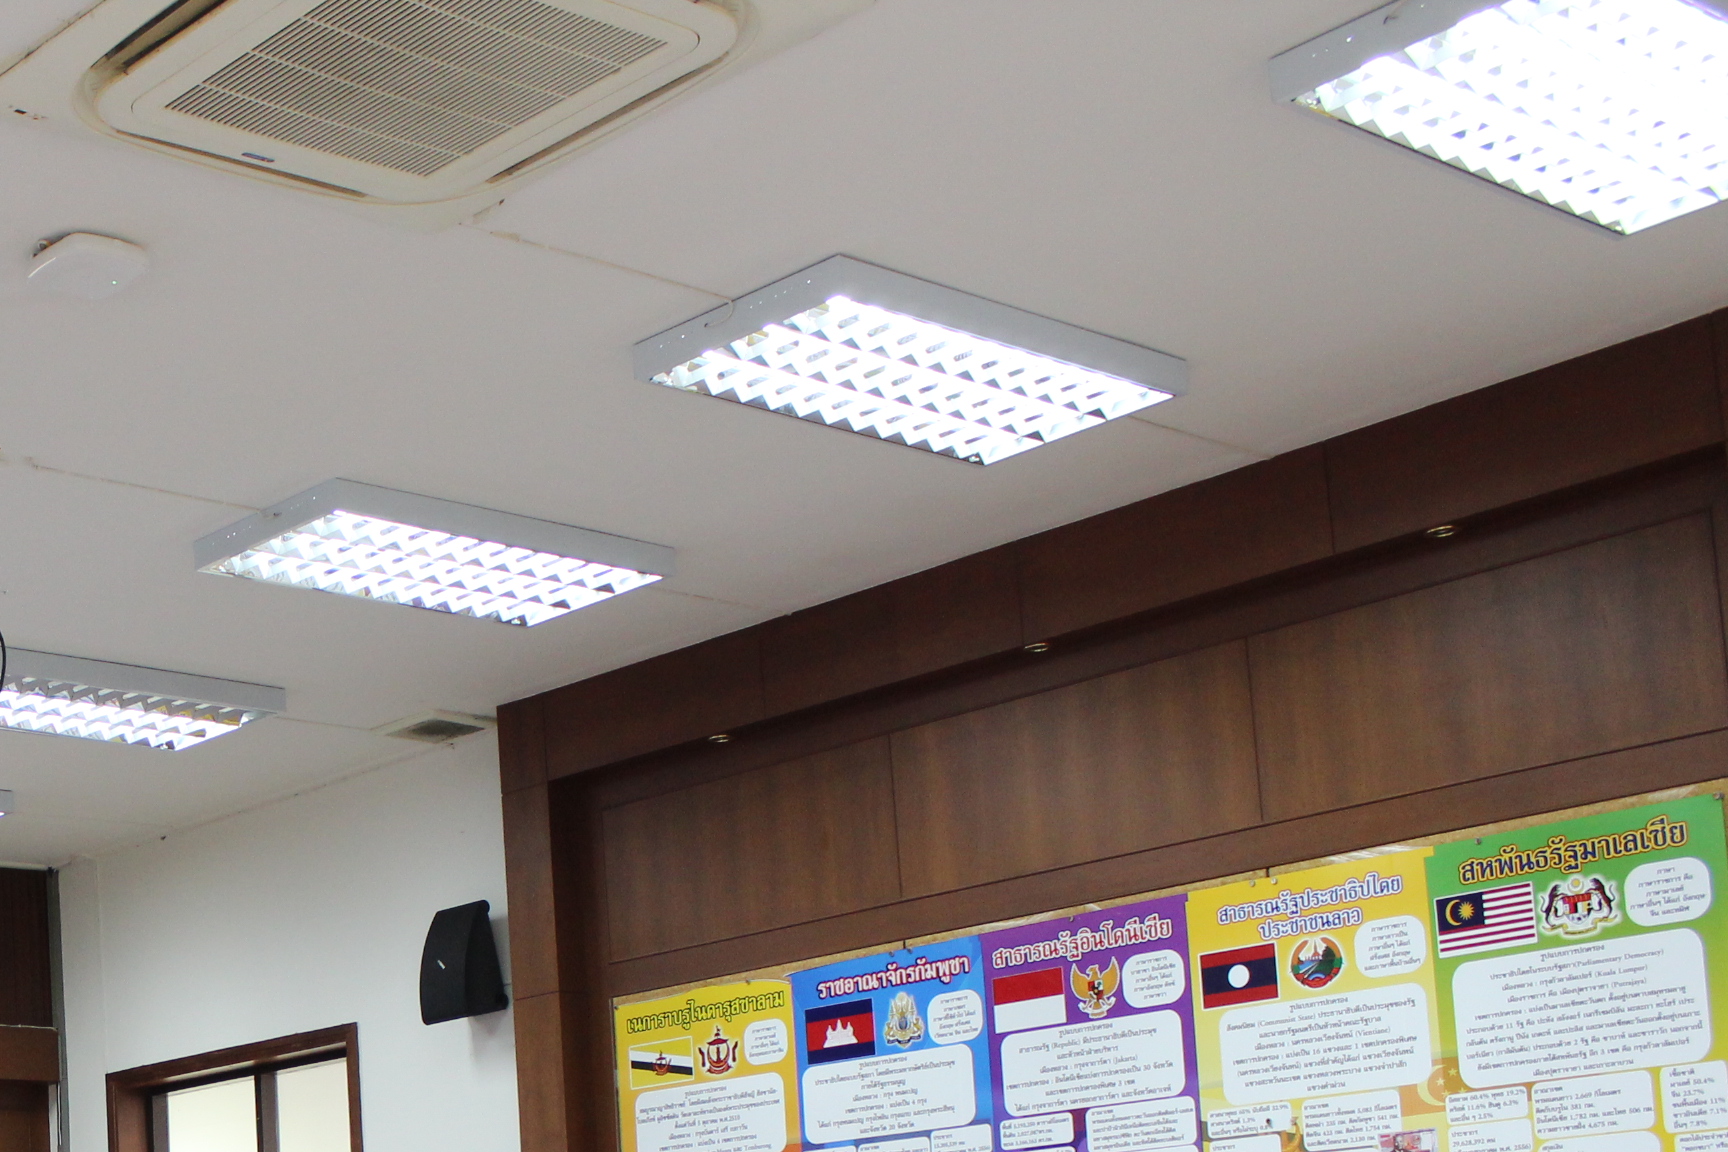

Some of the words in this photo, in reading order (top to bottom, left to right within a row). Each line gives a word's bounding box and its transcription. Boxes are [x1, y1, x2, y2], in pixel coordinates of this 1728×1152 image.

[1459, 815, 1687, 884] สหพันธรัฐมาเลเซีย
[1218, 872, 1402, 924] สาธารณรัฐประชาธิปไตย
[1259, 908, 1361, 940] ประชาชนลาว
[993, 913, 1172, 968] สาธารณรัฐอินโดนีเซีย
[817, 957, 970, 999] ราชอาณาจักรกัมพูชา
